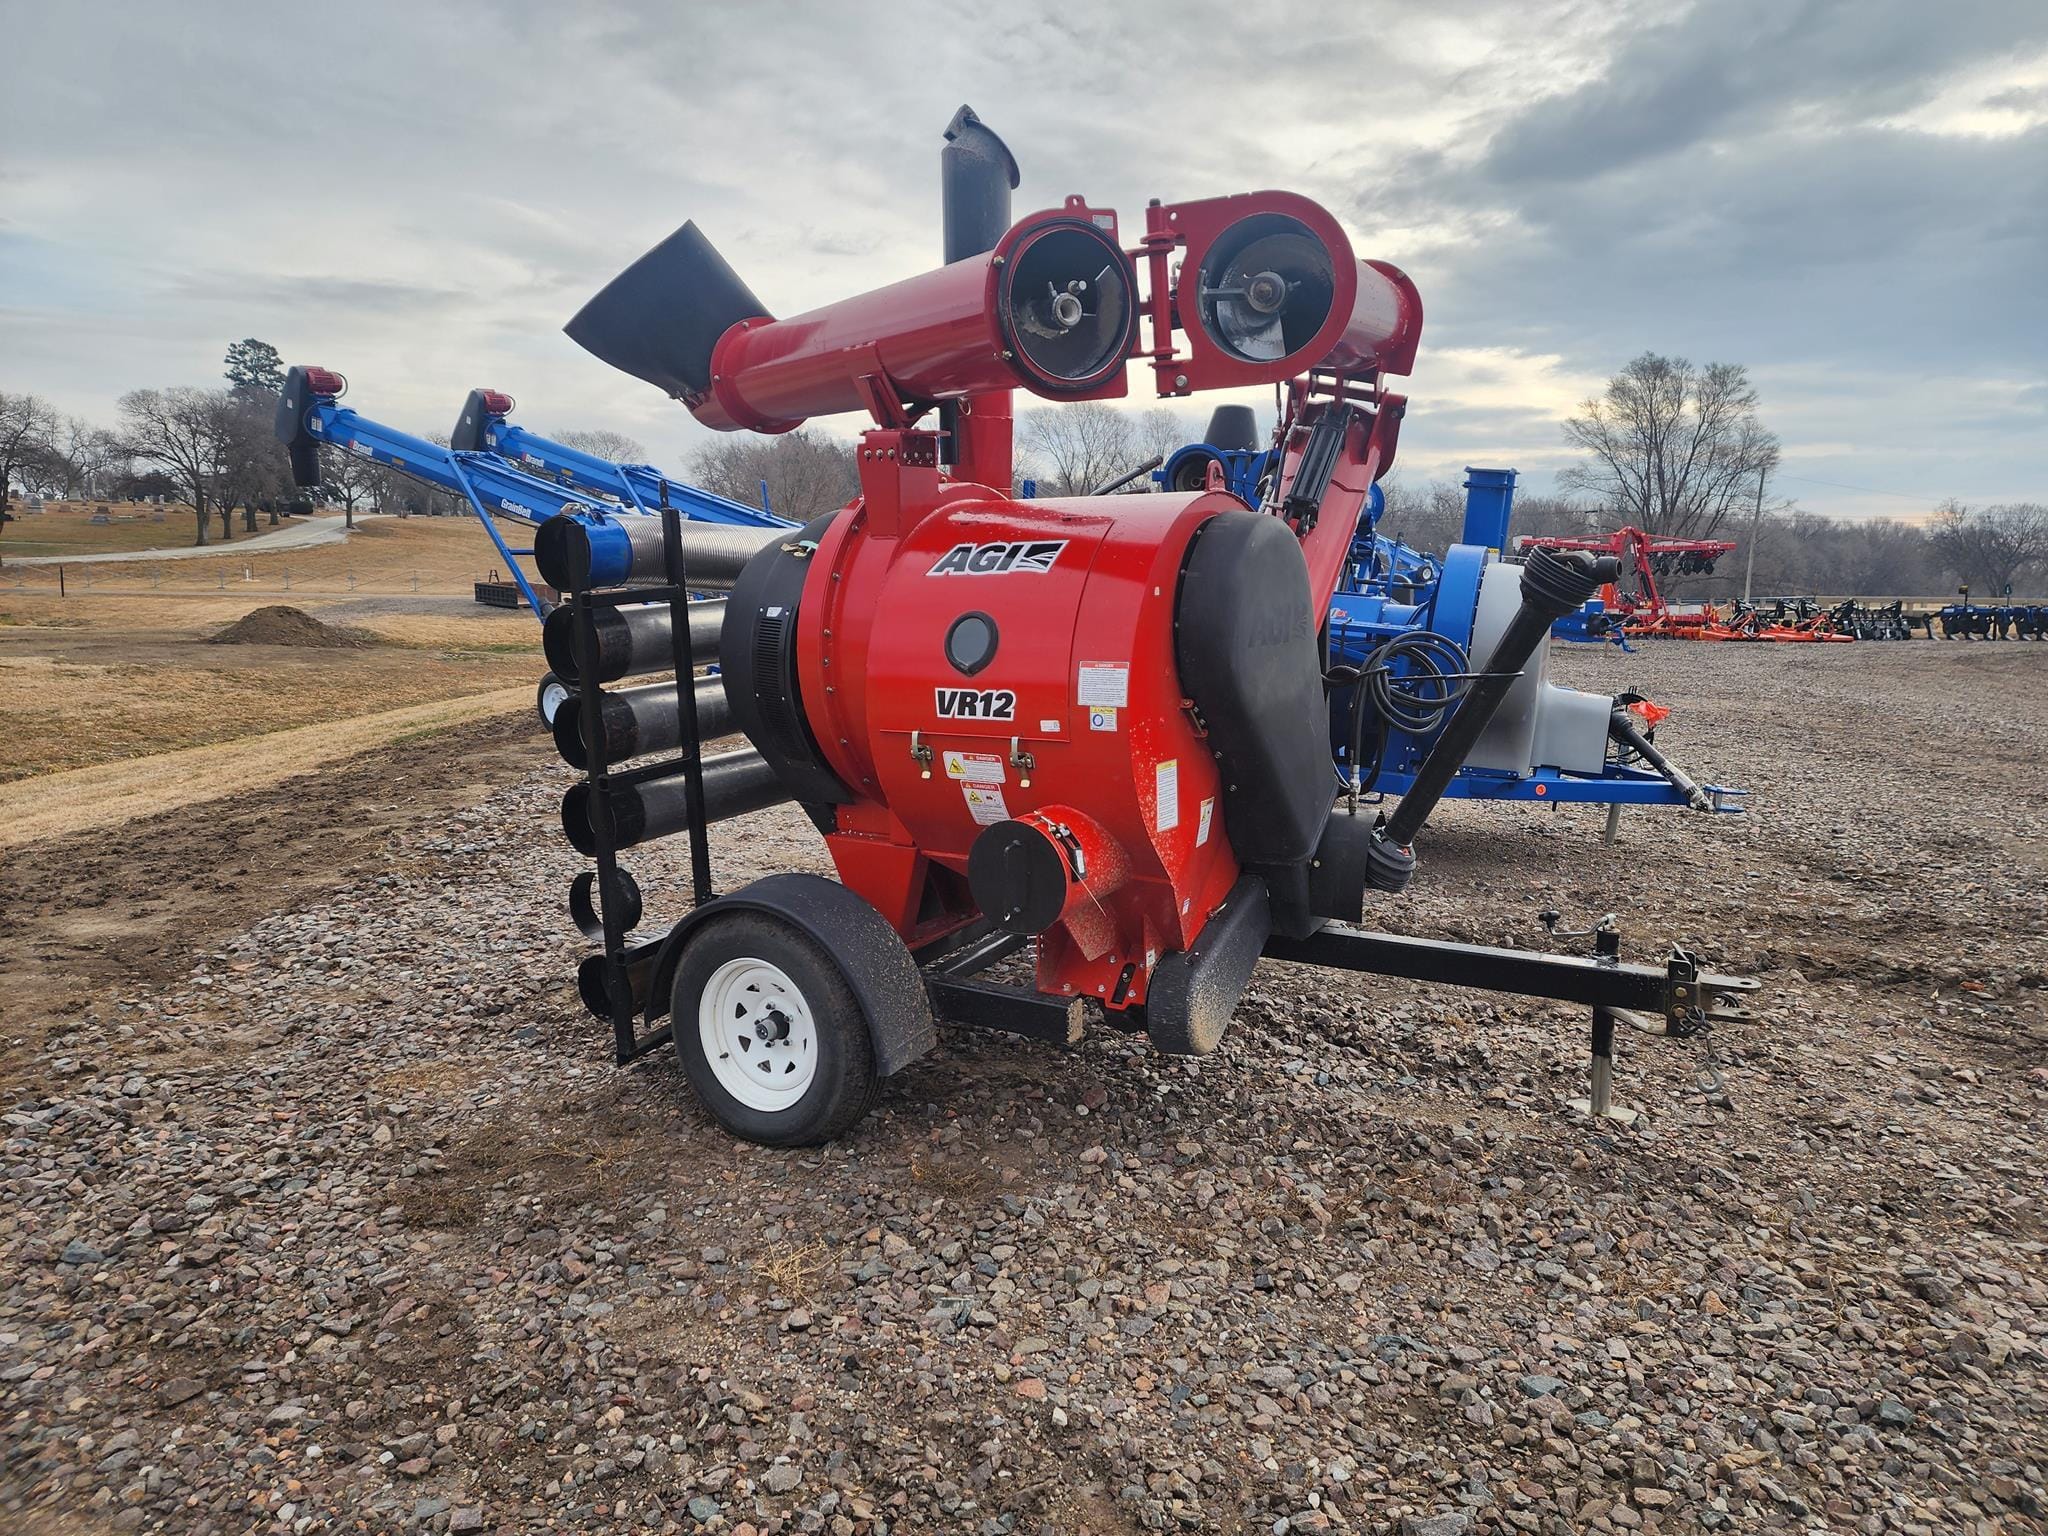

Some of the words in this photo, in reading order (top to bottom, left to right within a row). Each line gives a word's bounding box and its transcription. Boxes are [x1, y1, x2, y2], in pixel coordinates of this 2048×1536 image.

[928, 541, 1026, 574] AGI
[936, 690, 1015, 719] VR12
[972, 783, 996, 791] DANGER
